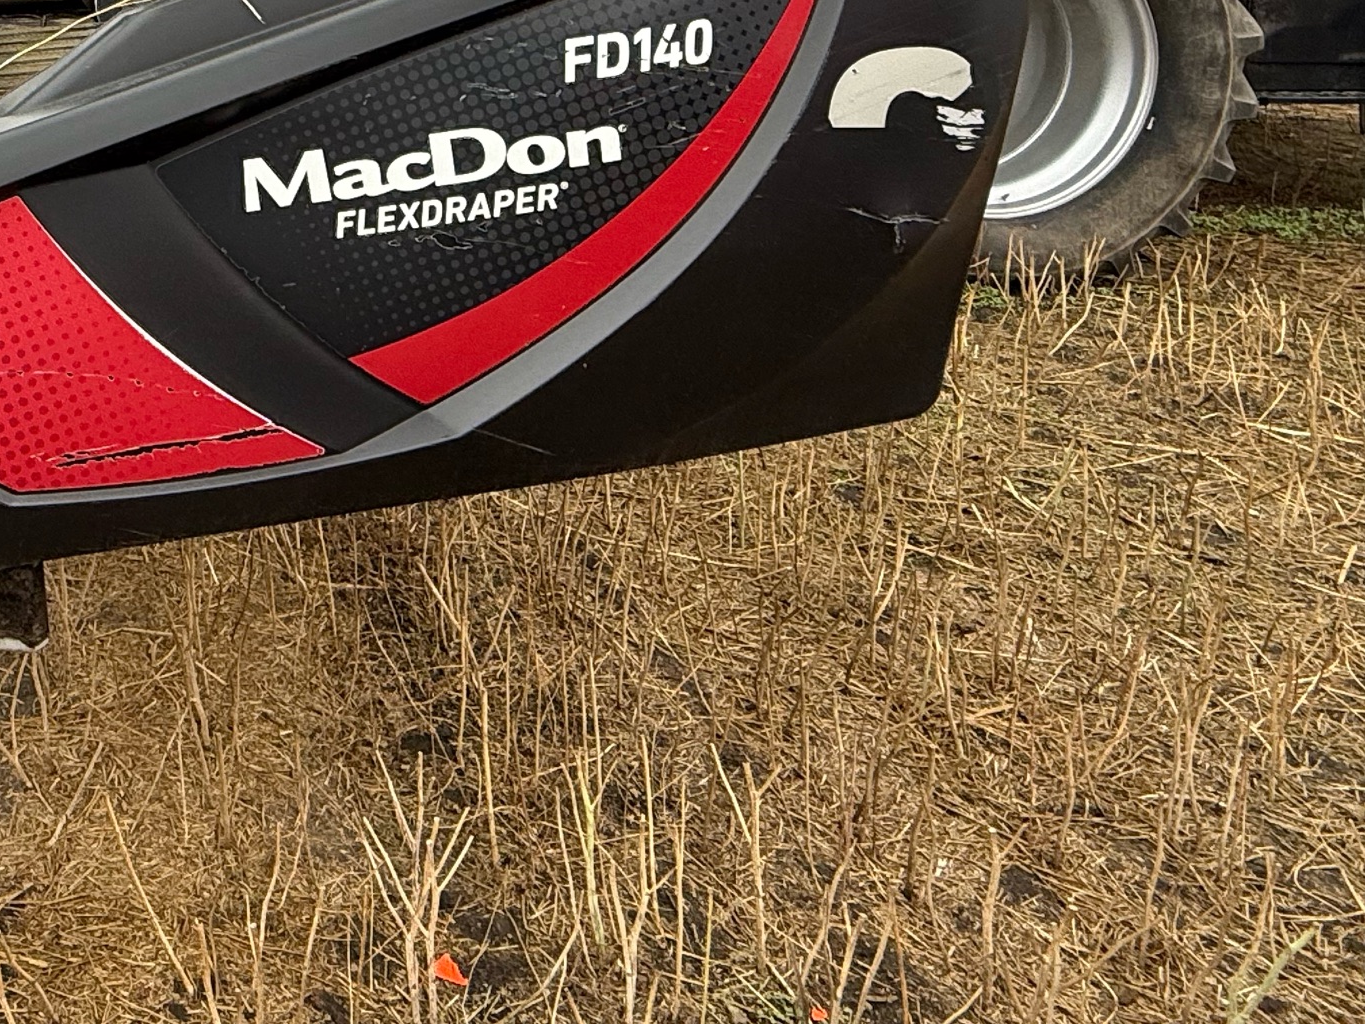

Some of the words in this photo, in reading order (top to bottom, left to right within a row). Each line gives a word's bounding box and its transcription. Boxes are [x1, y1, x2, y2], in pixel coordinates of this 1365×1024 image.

[564, 19, 714, 83] FD140
[242, 126, 622, 212] MacDon
[336, 184, 559, 239] FLEXDRAPER
